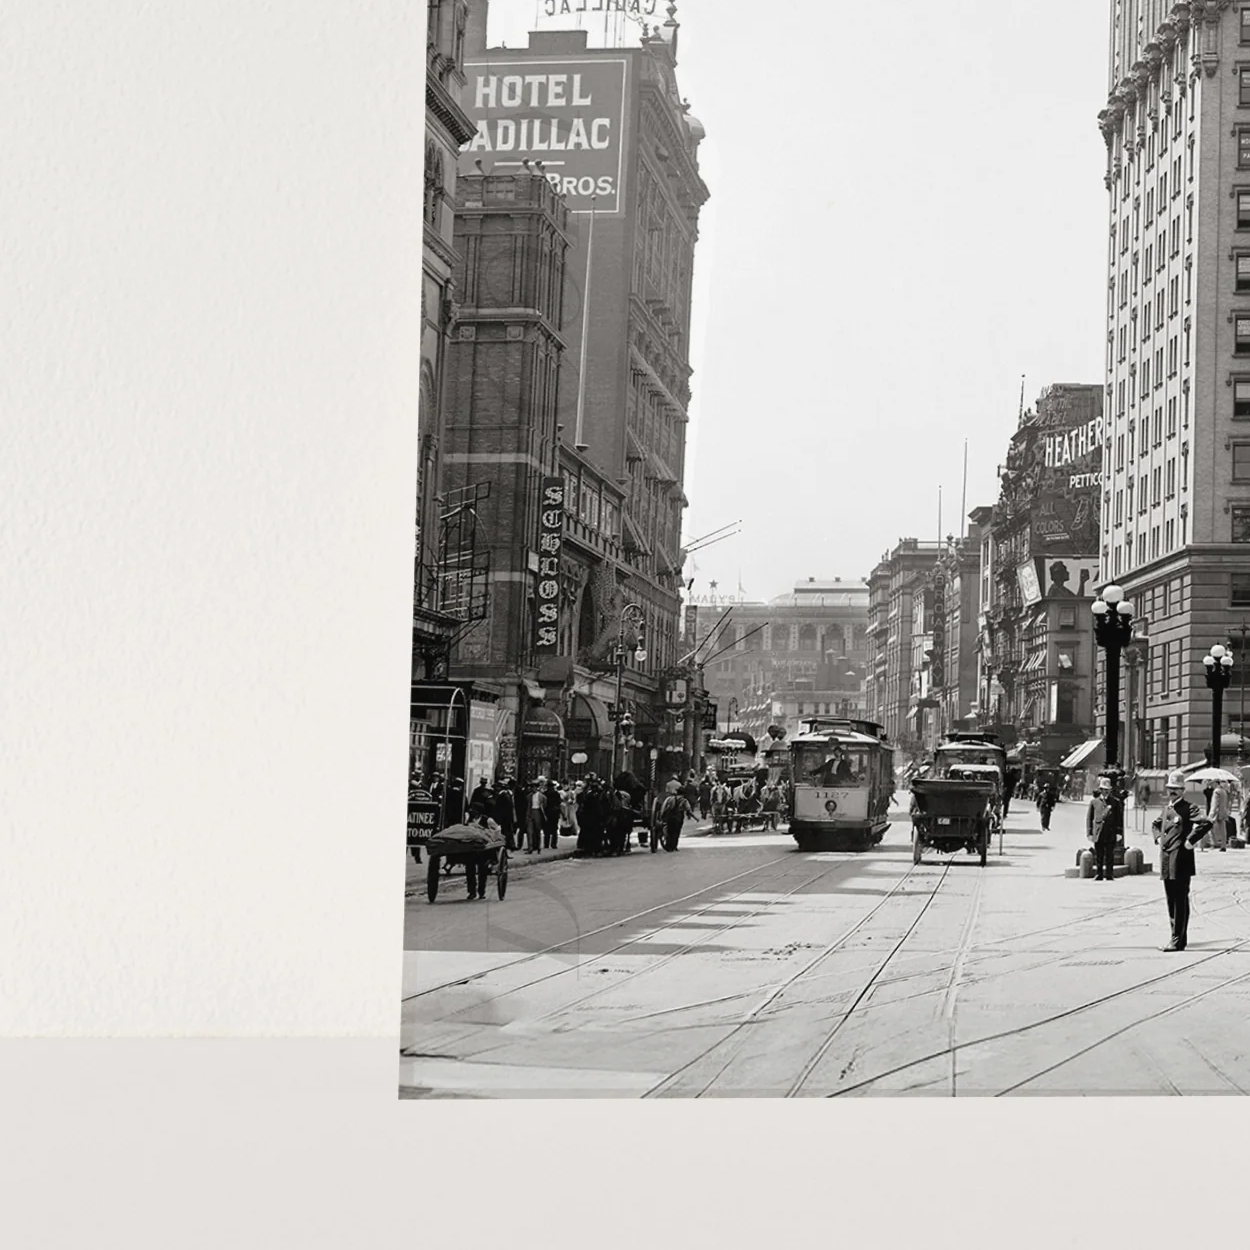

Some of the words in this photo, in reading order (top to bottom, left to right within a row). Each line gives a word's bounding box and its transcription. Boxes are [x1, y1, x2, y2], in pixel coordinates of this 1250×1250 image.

[474, 73, 592, 108] HOTEL
[1045, 415, 1103, 467] HEATHER
[933, 575, 945, 684] BROADWAY
[814, 791, 849, 799] 1127
[408, 811, 435, 825] ATINEE
